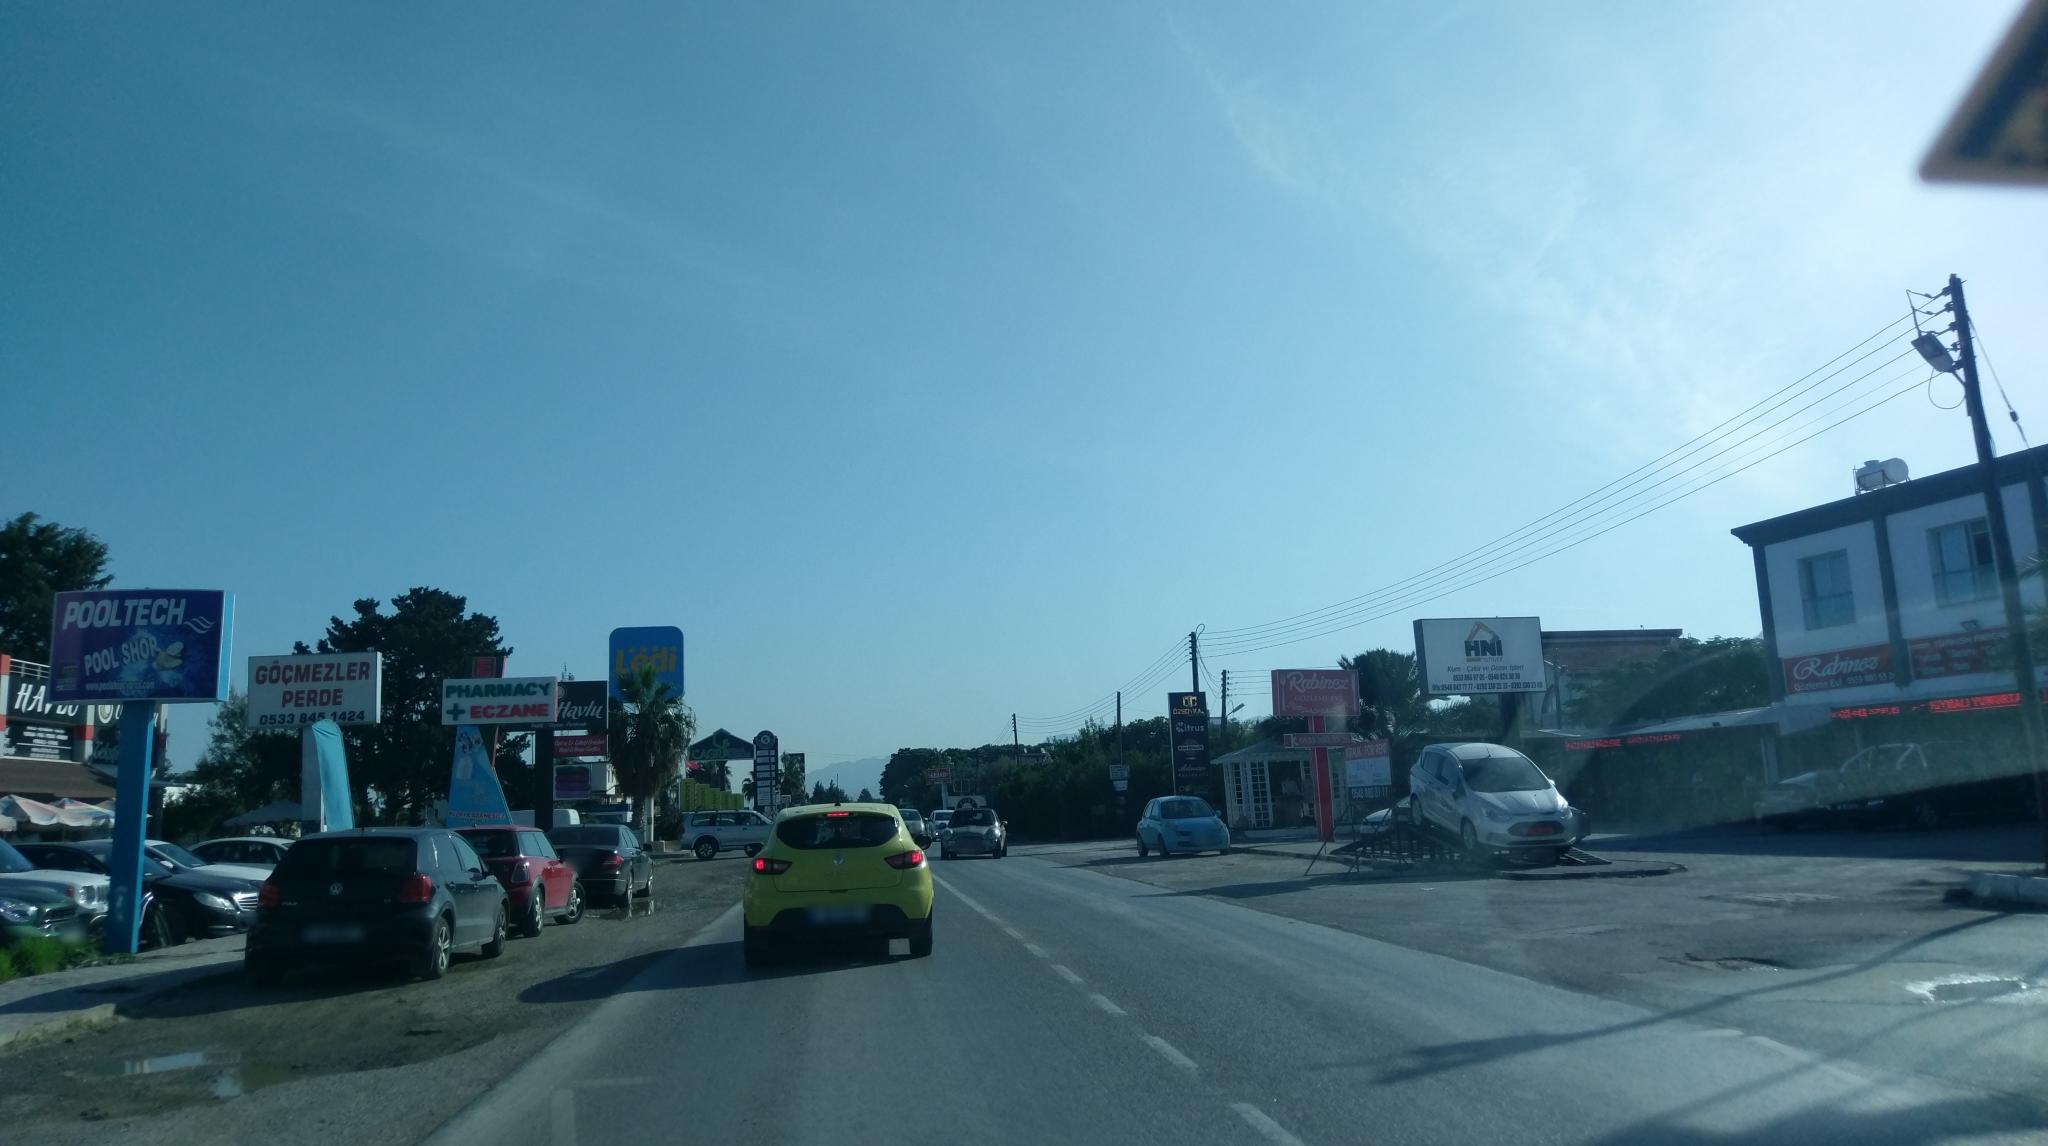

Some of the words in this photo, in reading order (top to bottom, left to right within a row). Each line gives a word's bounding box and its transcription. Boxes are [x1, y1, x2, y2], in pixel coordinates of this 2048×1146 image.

[62, 598, 187, 630] POOLTECH
[84, 647, 119, 676] POOL
[121, 635, 158, 664] SHOP
[1464, 639, 1503, 657] HNI
[255, 660, 370, 686] GÖÇMEZLER
[1793, 653, 1879, 680] Rabinez
[445, 682, 551, 698] PHARMACY
[1287, 671, 1348, 693] Rabinez
[282, 688, 343, 708] PERDE
[259, 713, 295, 726] 0533
[299, 711, 326, 723] 845
[330, 710, 365, 722] 1424
[470, 703, 549, 719] ECZANE
[557, 700, 605, 719] Havlu
